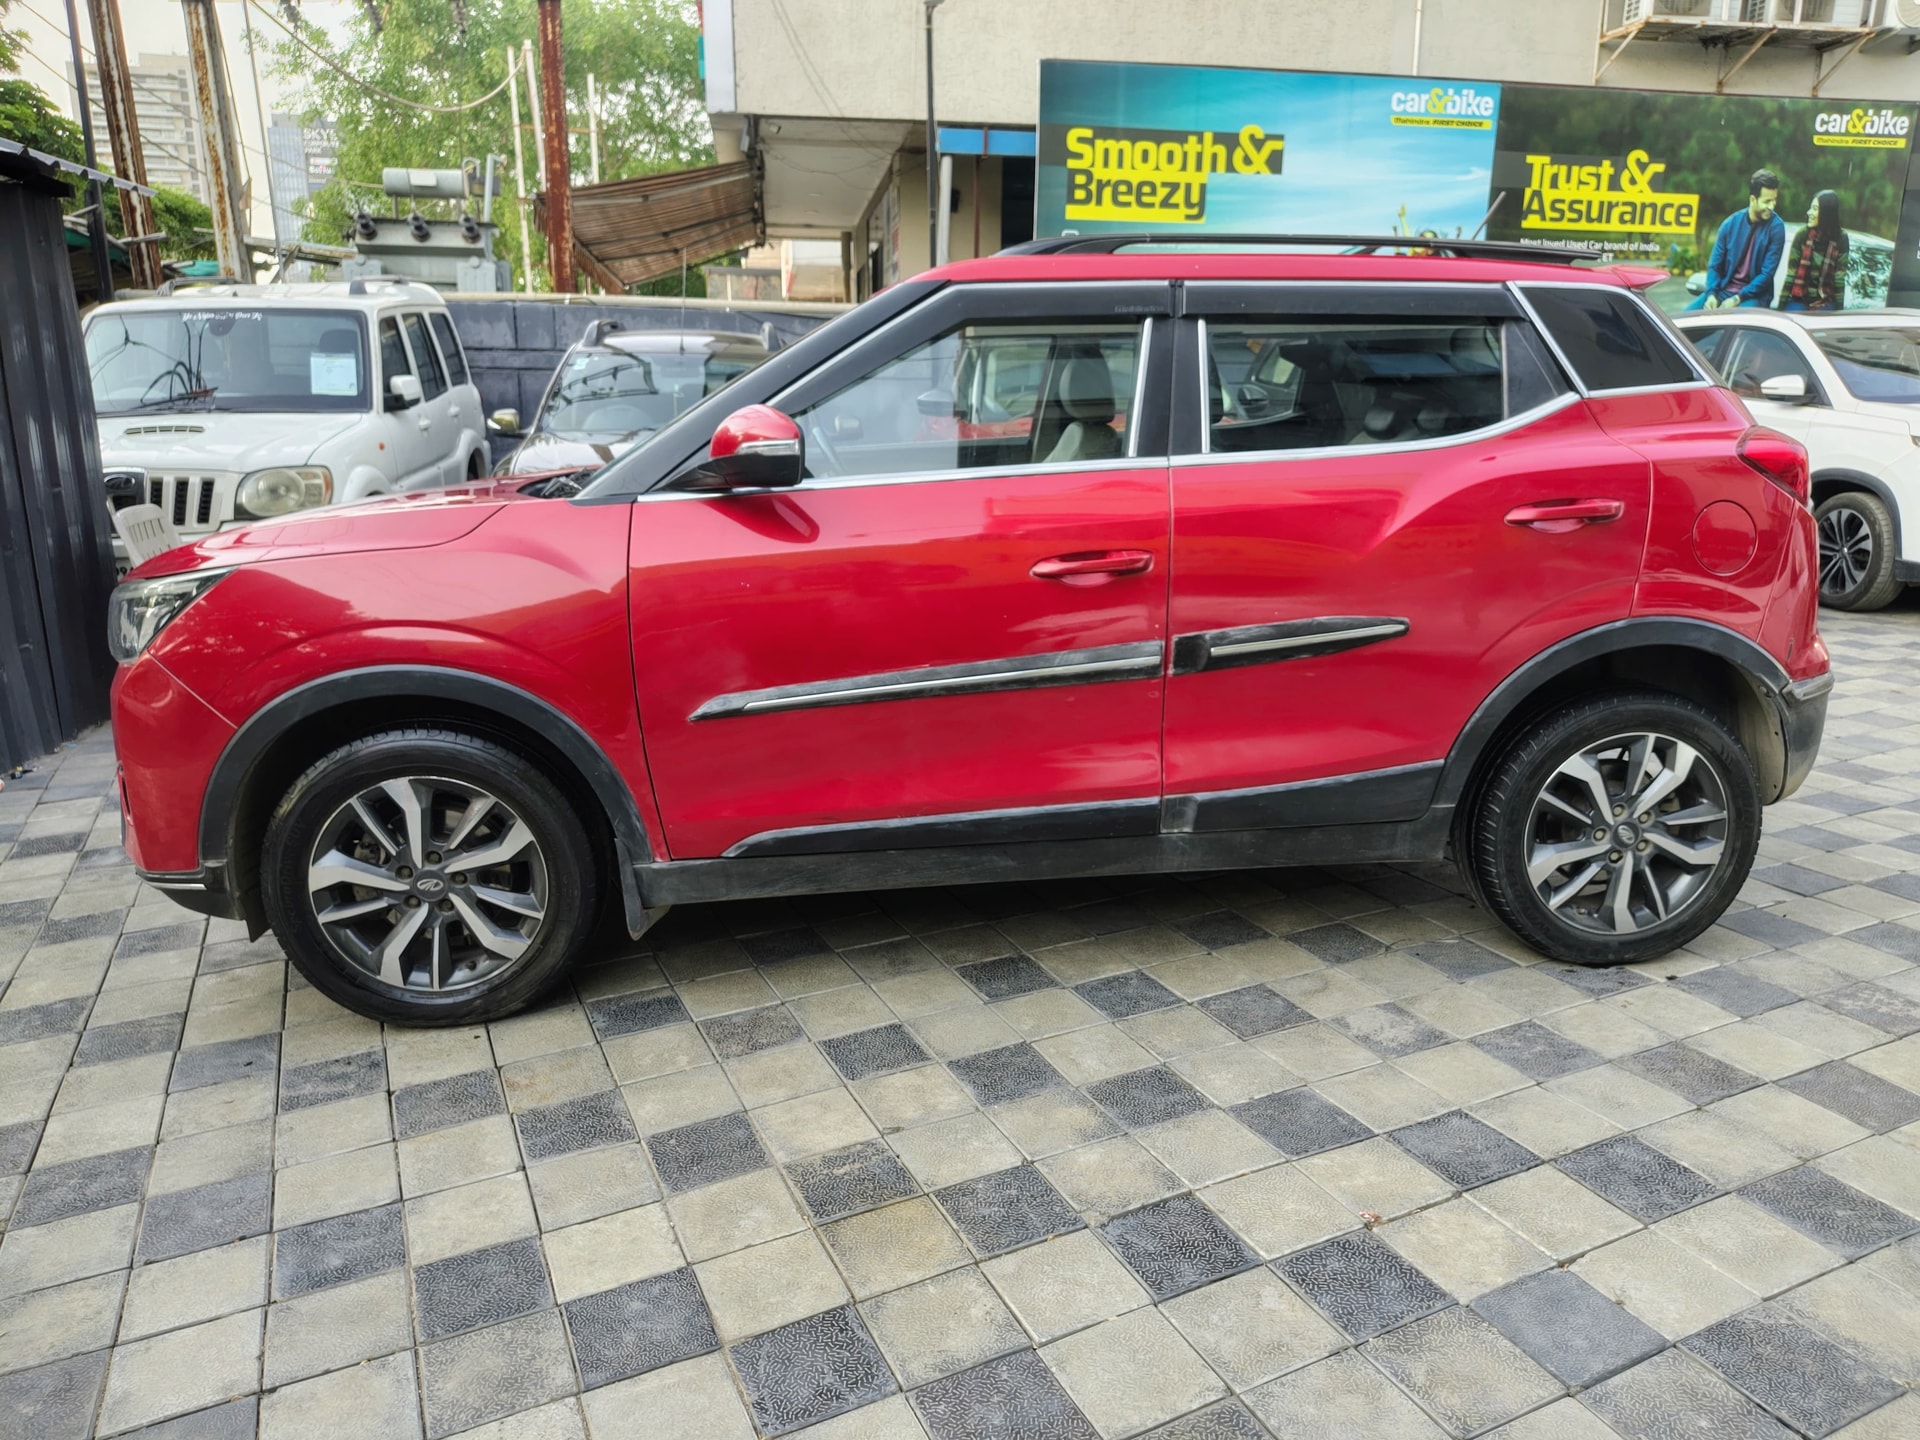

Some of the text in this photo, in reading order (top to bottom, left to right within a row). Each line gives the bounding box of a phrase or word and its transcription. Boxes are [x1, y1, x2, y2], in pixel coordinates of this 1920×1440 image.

[1391, 87, 1494, 117] car&bike
[1815, 108, 1910, 135] car&bike
[1066, 124, 1285, 174] Smooth &
[1525, 149, 1666, 194] Trust &
[1067, 168, 1208, 221] Breezy
[1522, 189, 1693, 228] Assurance
[1588, 240, 1602, 250] Car
[1603, 240, 1628, 251] brand
[1629, 241, 1638, 251] of
[1640, 241, 1660, 252] India
